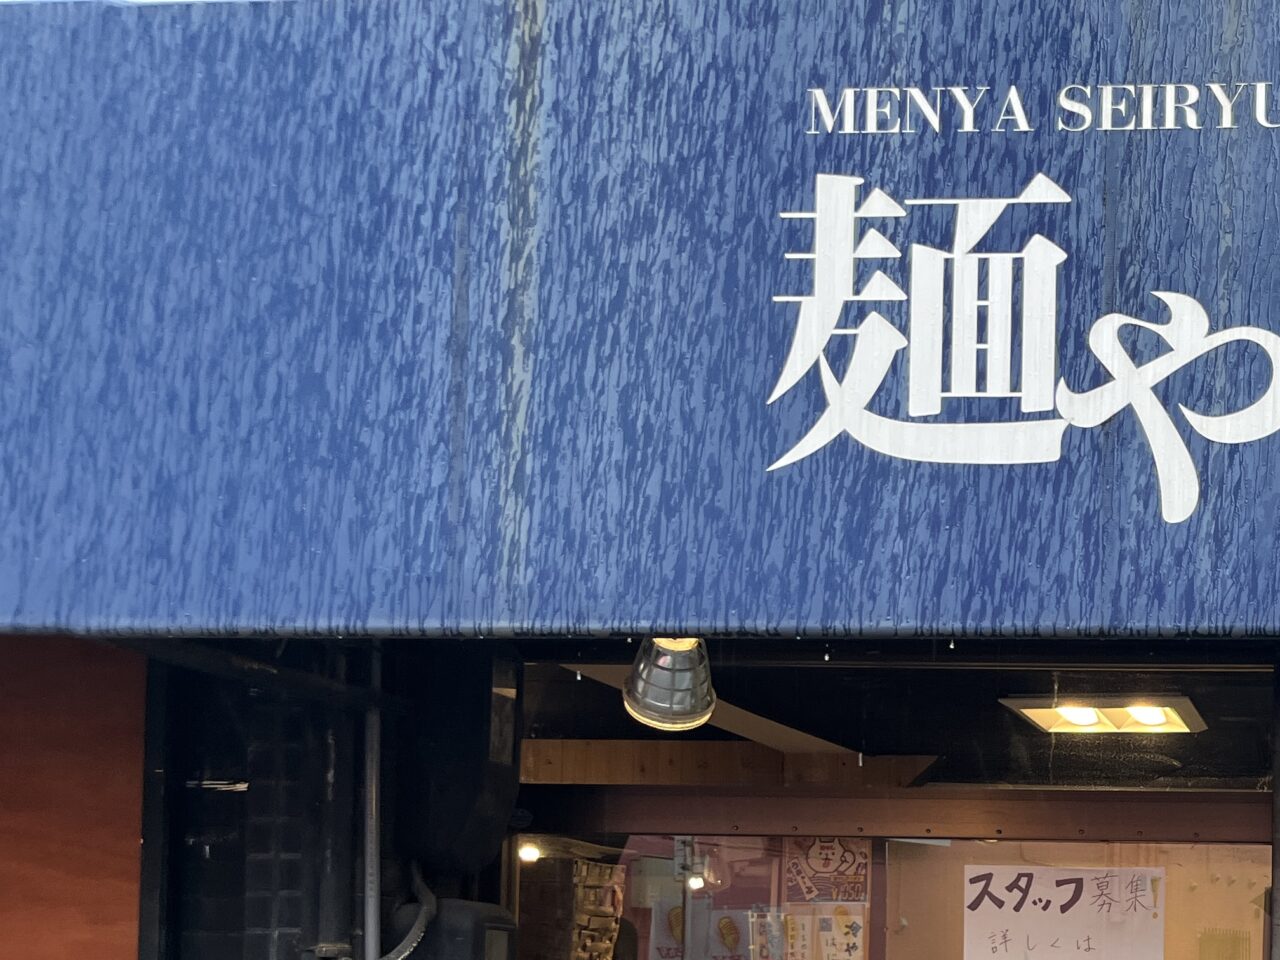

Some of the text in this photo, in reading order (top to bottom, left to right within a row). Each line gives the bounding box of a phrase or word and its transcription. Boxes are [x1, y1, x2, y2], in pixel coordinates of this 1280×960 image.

[806, 86, 1034, 135] MENYA
[988, 929, 1096, 953] 詳しくは
